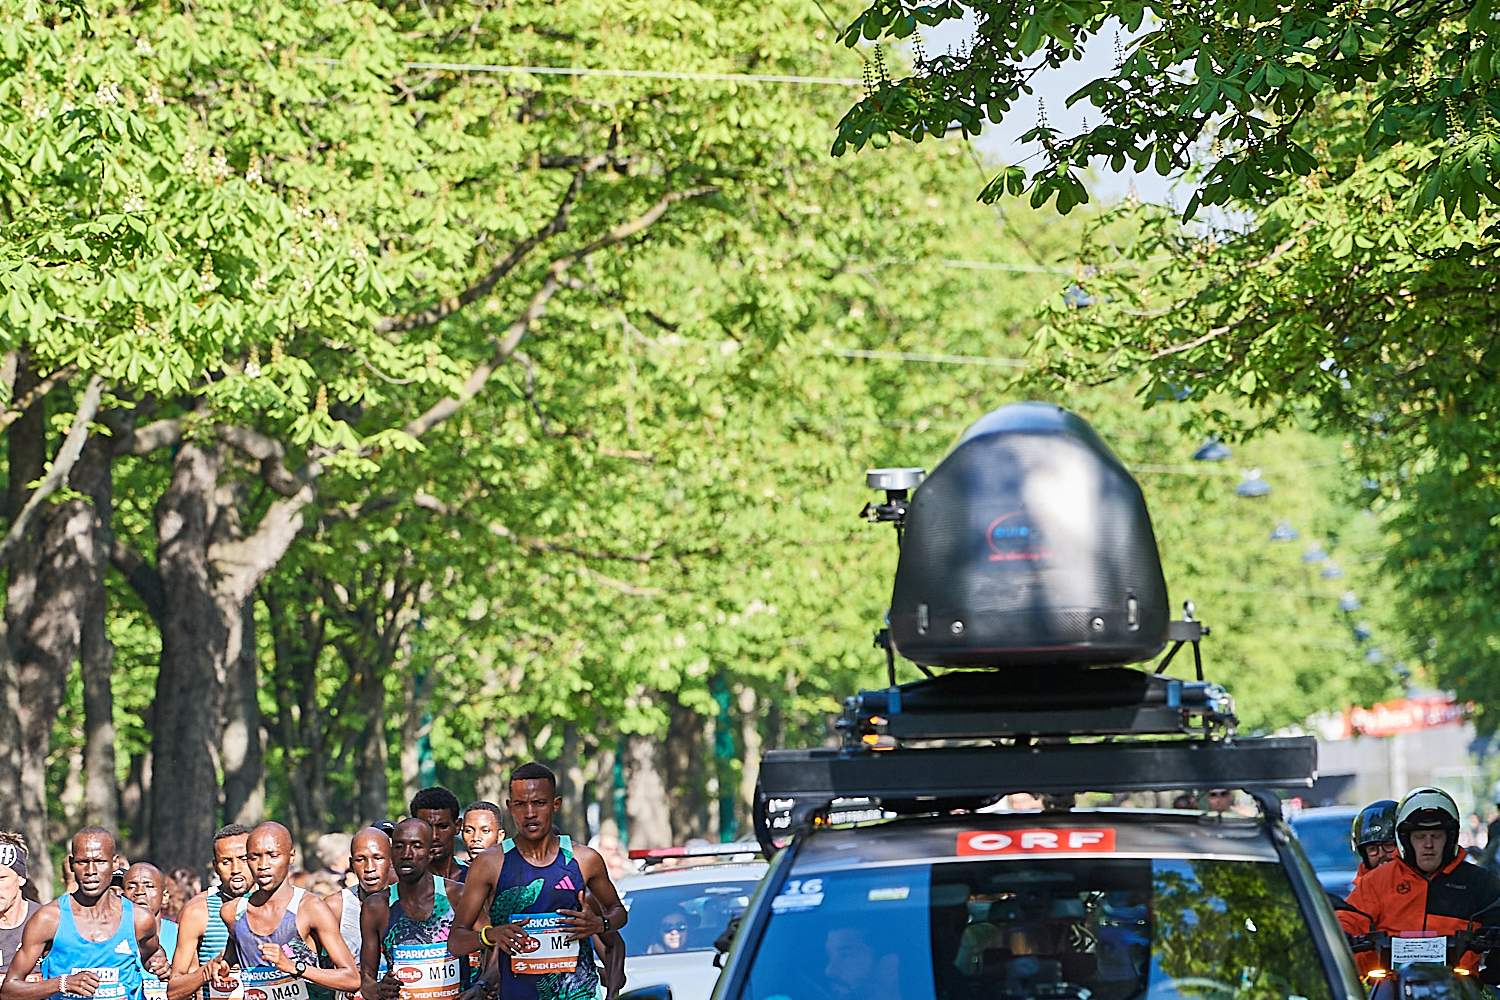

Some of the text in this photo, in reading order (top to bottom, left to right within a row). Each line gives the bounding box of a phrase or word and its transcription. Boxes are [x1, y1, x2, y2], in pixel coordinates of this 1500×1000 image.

[968, 831, 1104, 851] ORF
[395, 947, 448, 960] SPARKASSE
[429, 963, 456, 980] M16
[271, 983, 300, 1000] M40
[412, 991, 433, 999] WIEN
